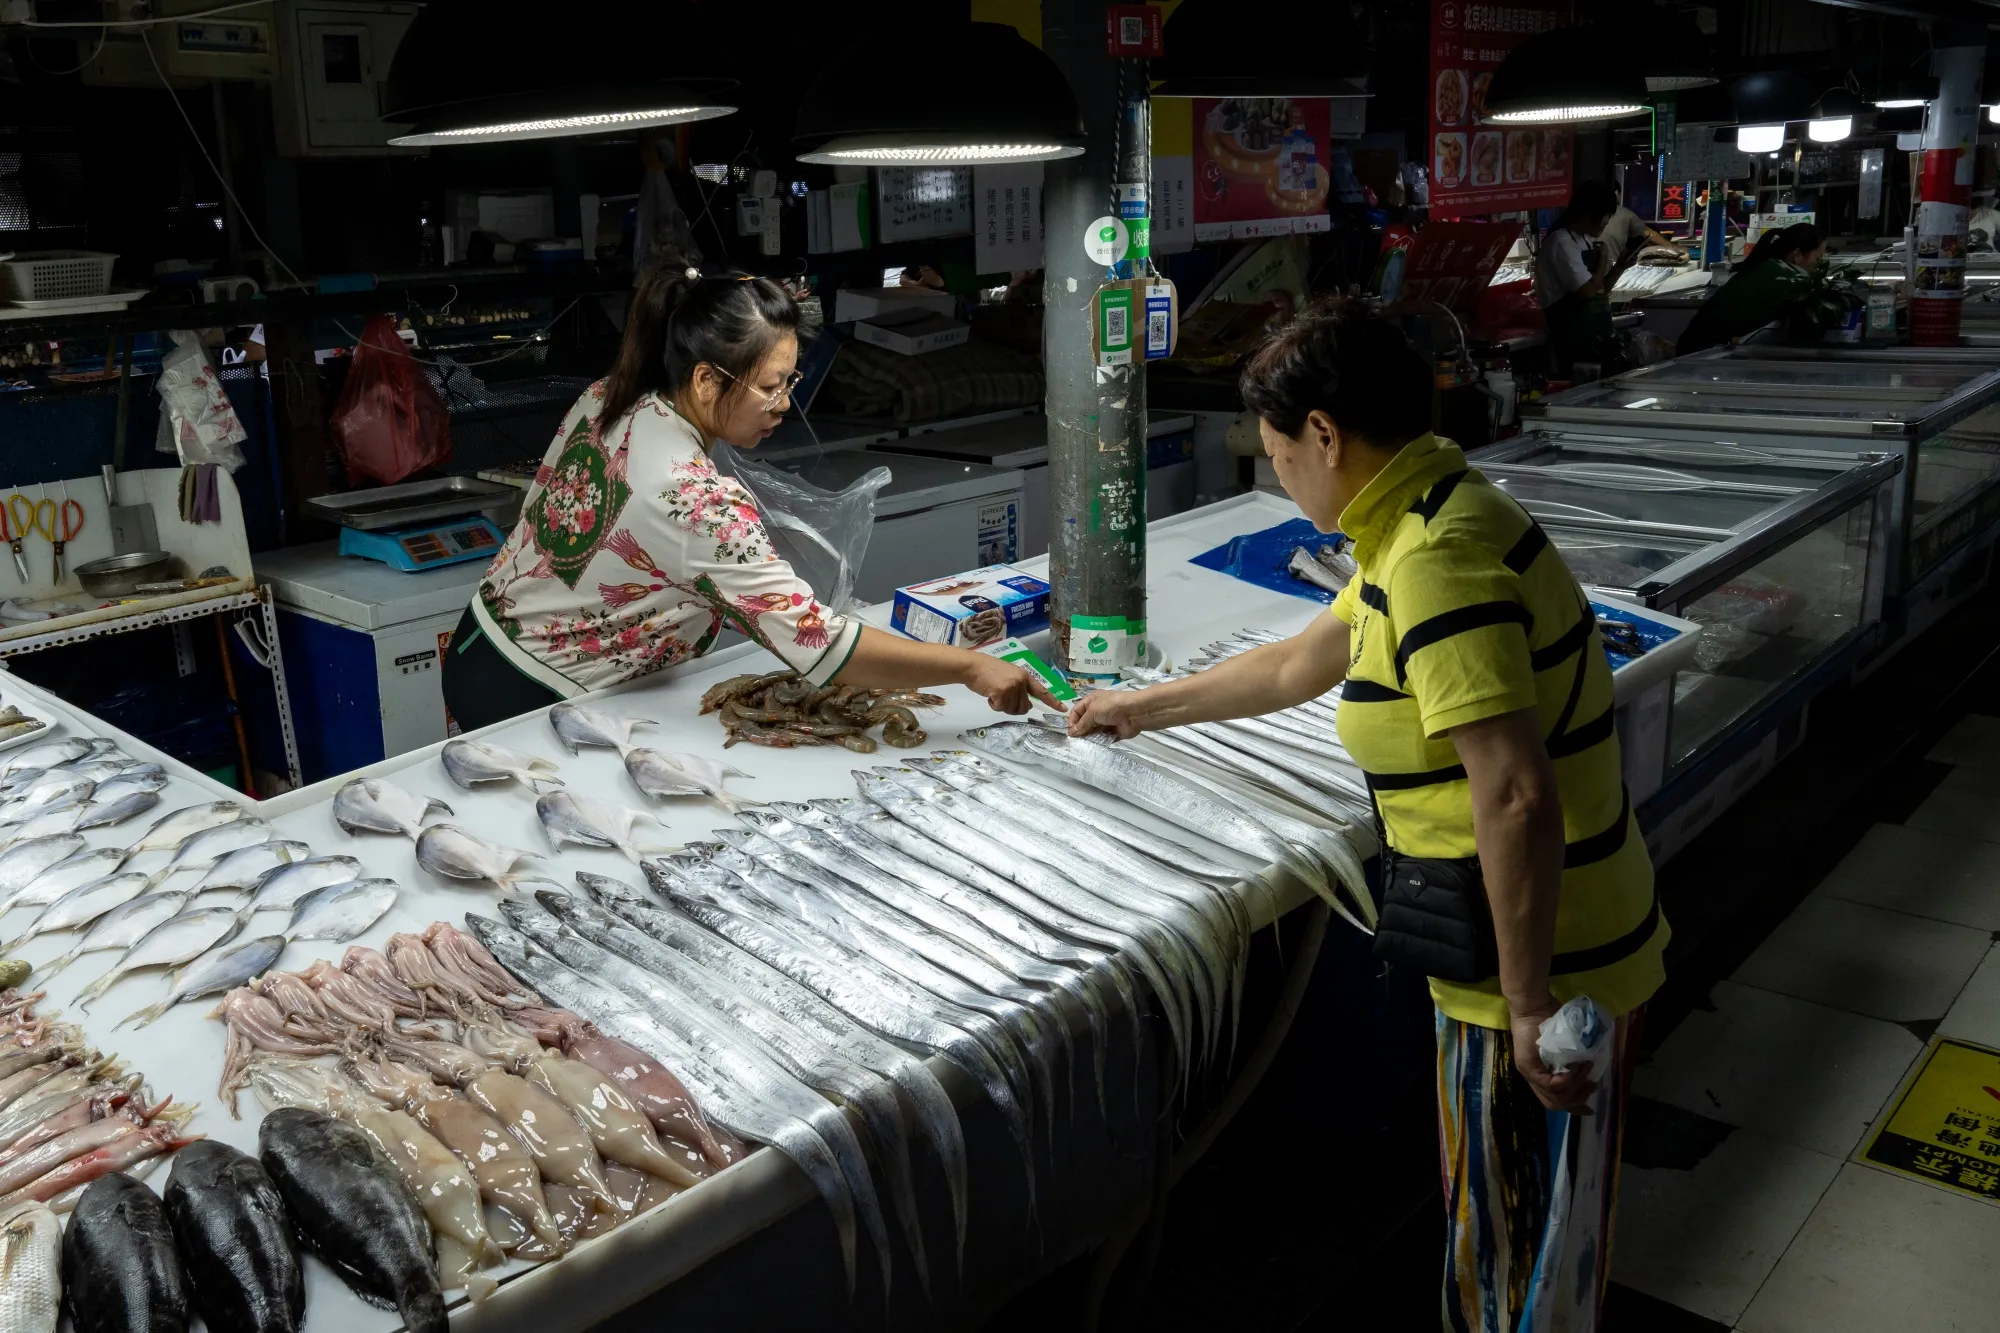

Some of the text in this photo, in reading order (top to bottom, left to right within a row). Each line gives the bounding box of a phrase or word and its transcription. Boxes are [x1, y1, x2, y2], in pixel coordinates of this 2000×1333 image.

[398, 657, 415, 665] Snow
[1084, 658, 1112, 666] 微信支付
[1913, 1155, 1999, 1191] 提示
